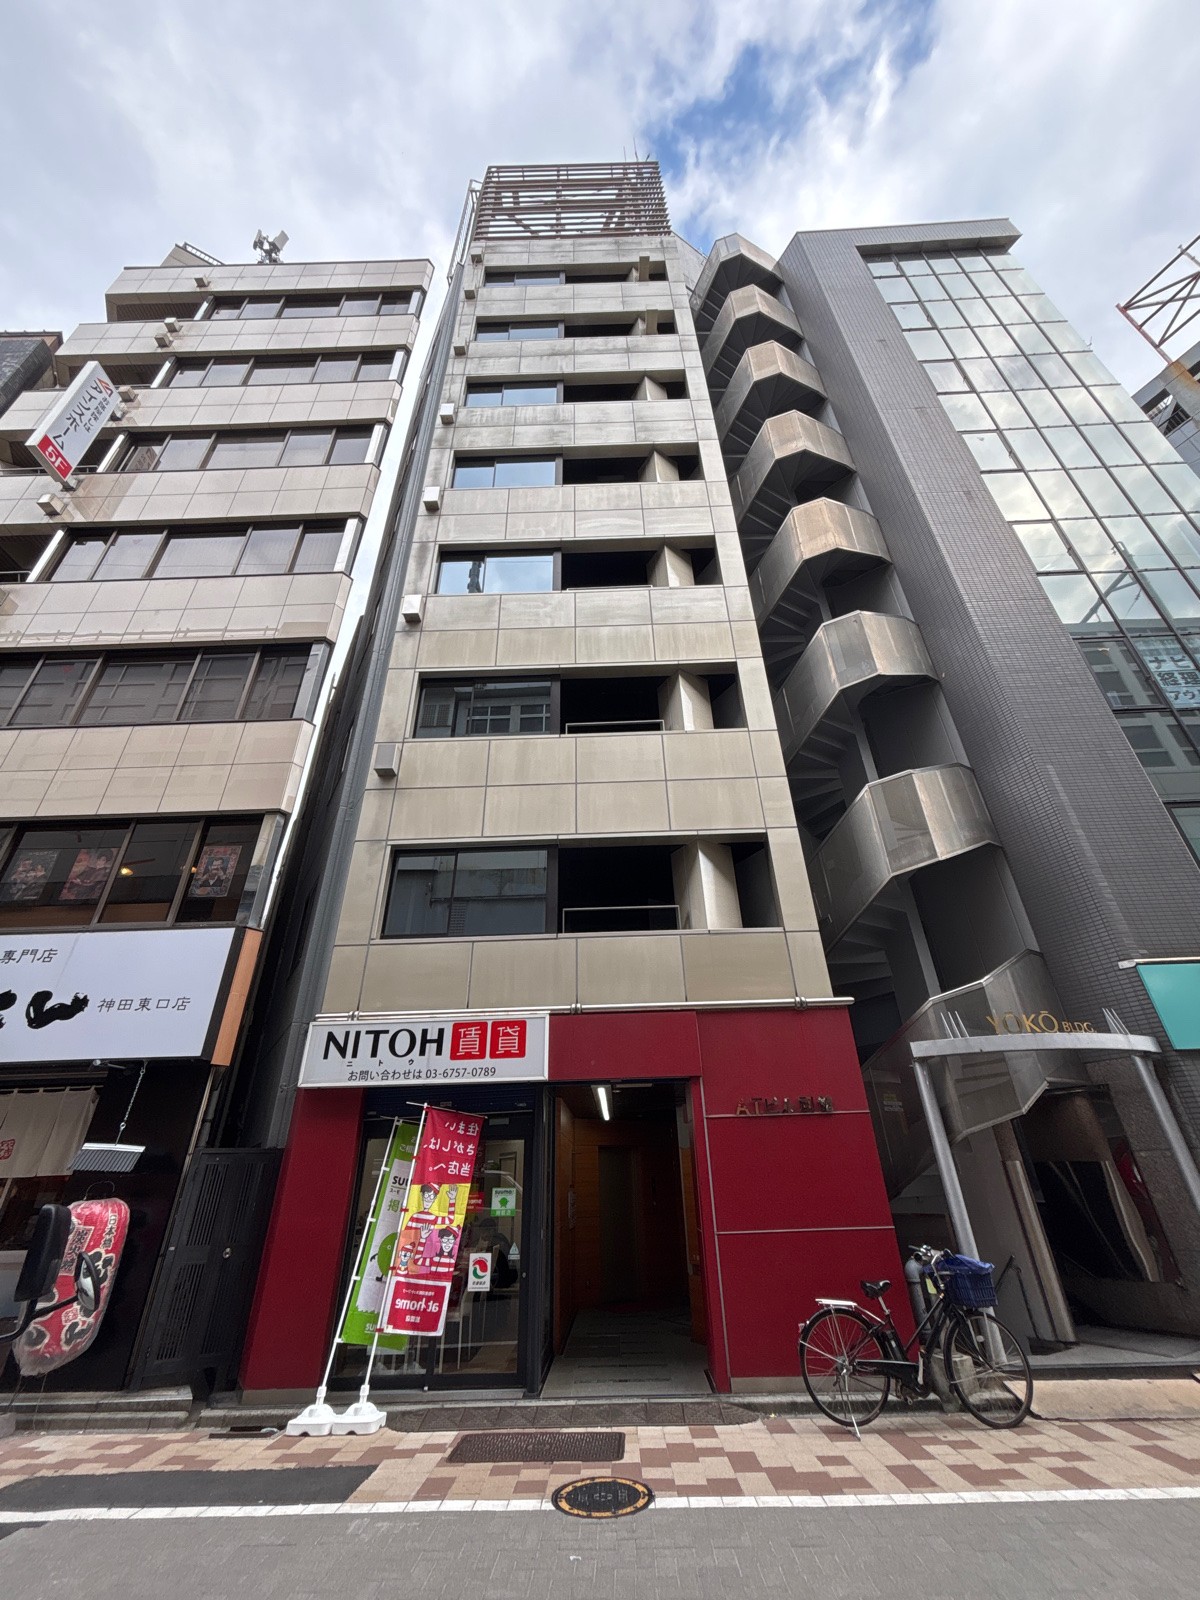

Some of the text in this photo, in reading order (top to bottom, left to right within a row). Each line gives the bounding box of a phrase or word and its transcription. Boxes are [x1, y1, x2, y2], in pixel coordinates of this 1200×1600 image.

[53, 379, 103, 451] アインスホーム
[45, 445, 68, 470] 5F
[1168, 689, 1200, 701] アウ
[97, 996, 191, 1013] 神田東口店
[322, 1024, 521, 1060] NITOH 賃貸
[347, 1067, 496, 1082] お問い合わせは 03-6757-0789
